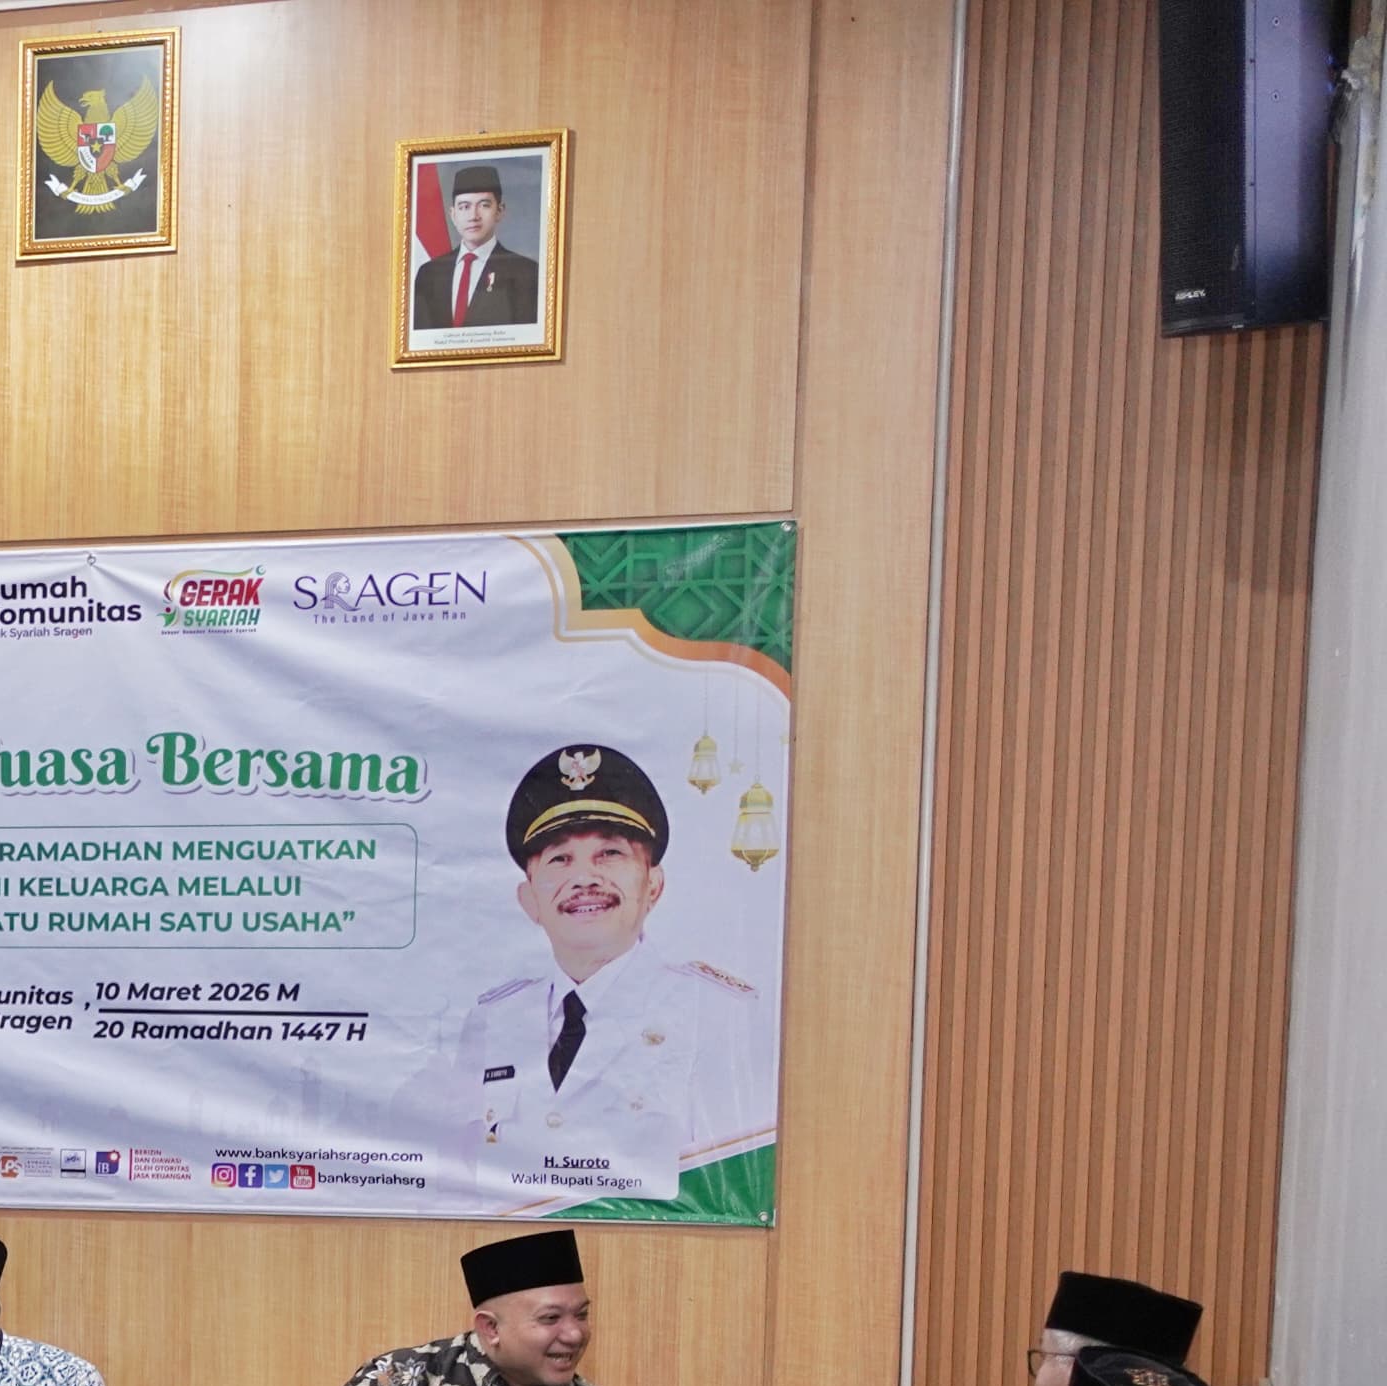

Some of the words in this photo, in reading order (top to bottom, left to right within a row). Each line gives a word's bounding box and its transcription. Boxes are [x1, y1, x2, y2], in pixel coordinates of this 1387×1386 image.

[179, 577, 264, 607] GERAK
[183, 607, 261, 627] SYARIAH
[313, 614, 336, 625] The
[343, 613, 375, 624] Land
[382, 612, 395, 622] of
[402, 611, 434, 622] Java
[442, 610, 467, 621] Man
[10, 627, 52, 641] Syariah
[54, 626, 93, 640] Sragen
[146, 731, 420, 795] Bersama
[172, 839, 376, 862] MENGUATKAN
[18, 876, 170, 897] KELUARGA
[177, 876, 302, 897] MELALUI
[48, 912, 152, 933] RUMAH
[159, 911, 233, 933] SATU
[241, 910, 356, 933] USAHA”
[95, 982, 120, 1001] 10
[126, 982, 201, 1002] Maret
[207, 983, 270, 1002] 2026
[276, 983, 300, 1002] M
[93, 1020, 125, 1040] 20
[130, 1020, 273, 1041] Ramadhan
[280, 1021, 341, 1042] 1447
[346, 1022, 367, 1042] H
[152, 1157, 182, 1165] DIAWASI
[215, 1147, 423, 1164] www.banksyariahsragen.com
[544, 1157, 560, 1169] H.
[562, 1156, 610, 1170] Suroto
[133, 1172, 150, 1180] JASA
[155, 1165, 190, 1173] OTORITAS
[296, 1166, 310, 1176] You
[317, 1171, 426, 1188] banksyariahsrg
[511, 1172, 547, 1186] Wakil
[550, 1173, 593, 1188] Bupati
[596, 1175, 643, 1190] Sragen
